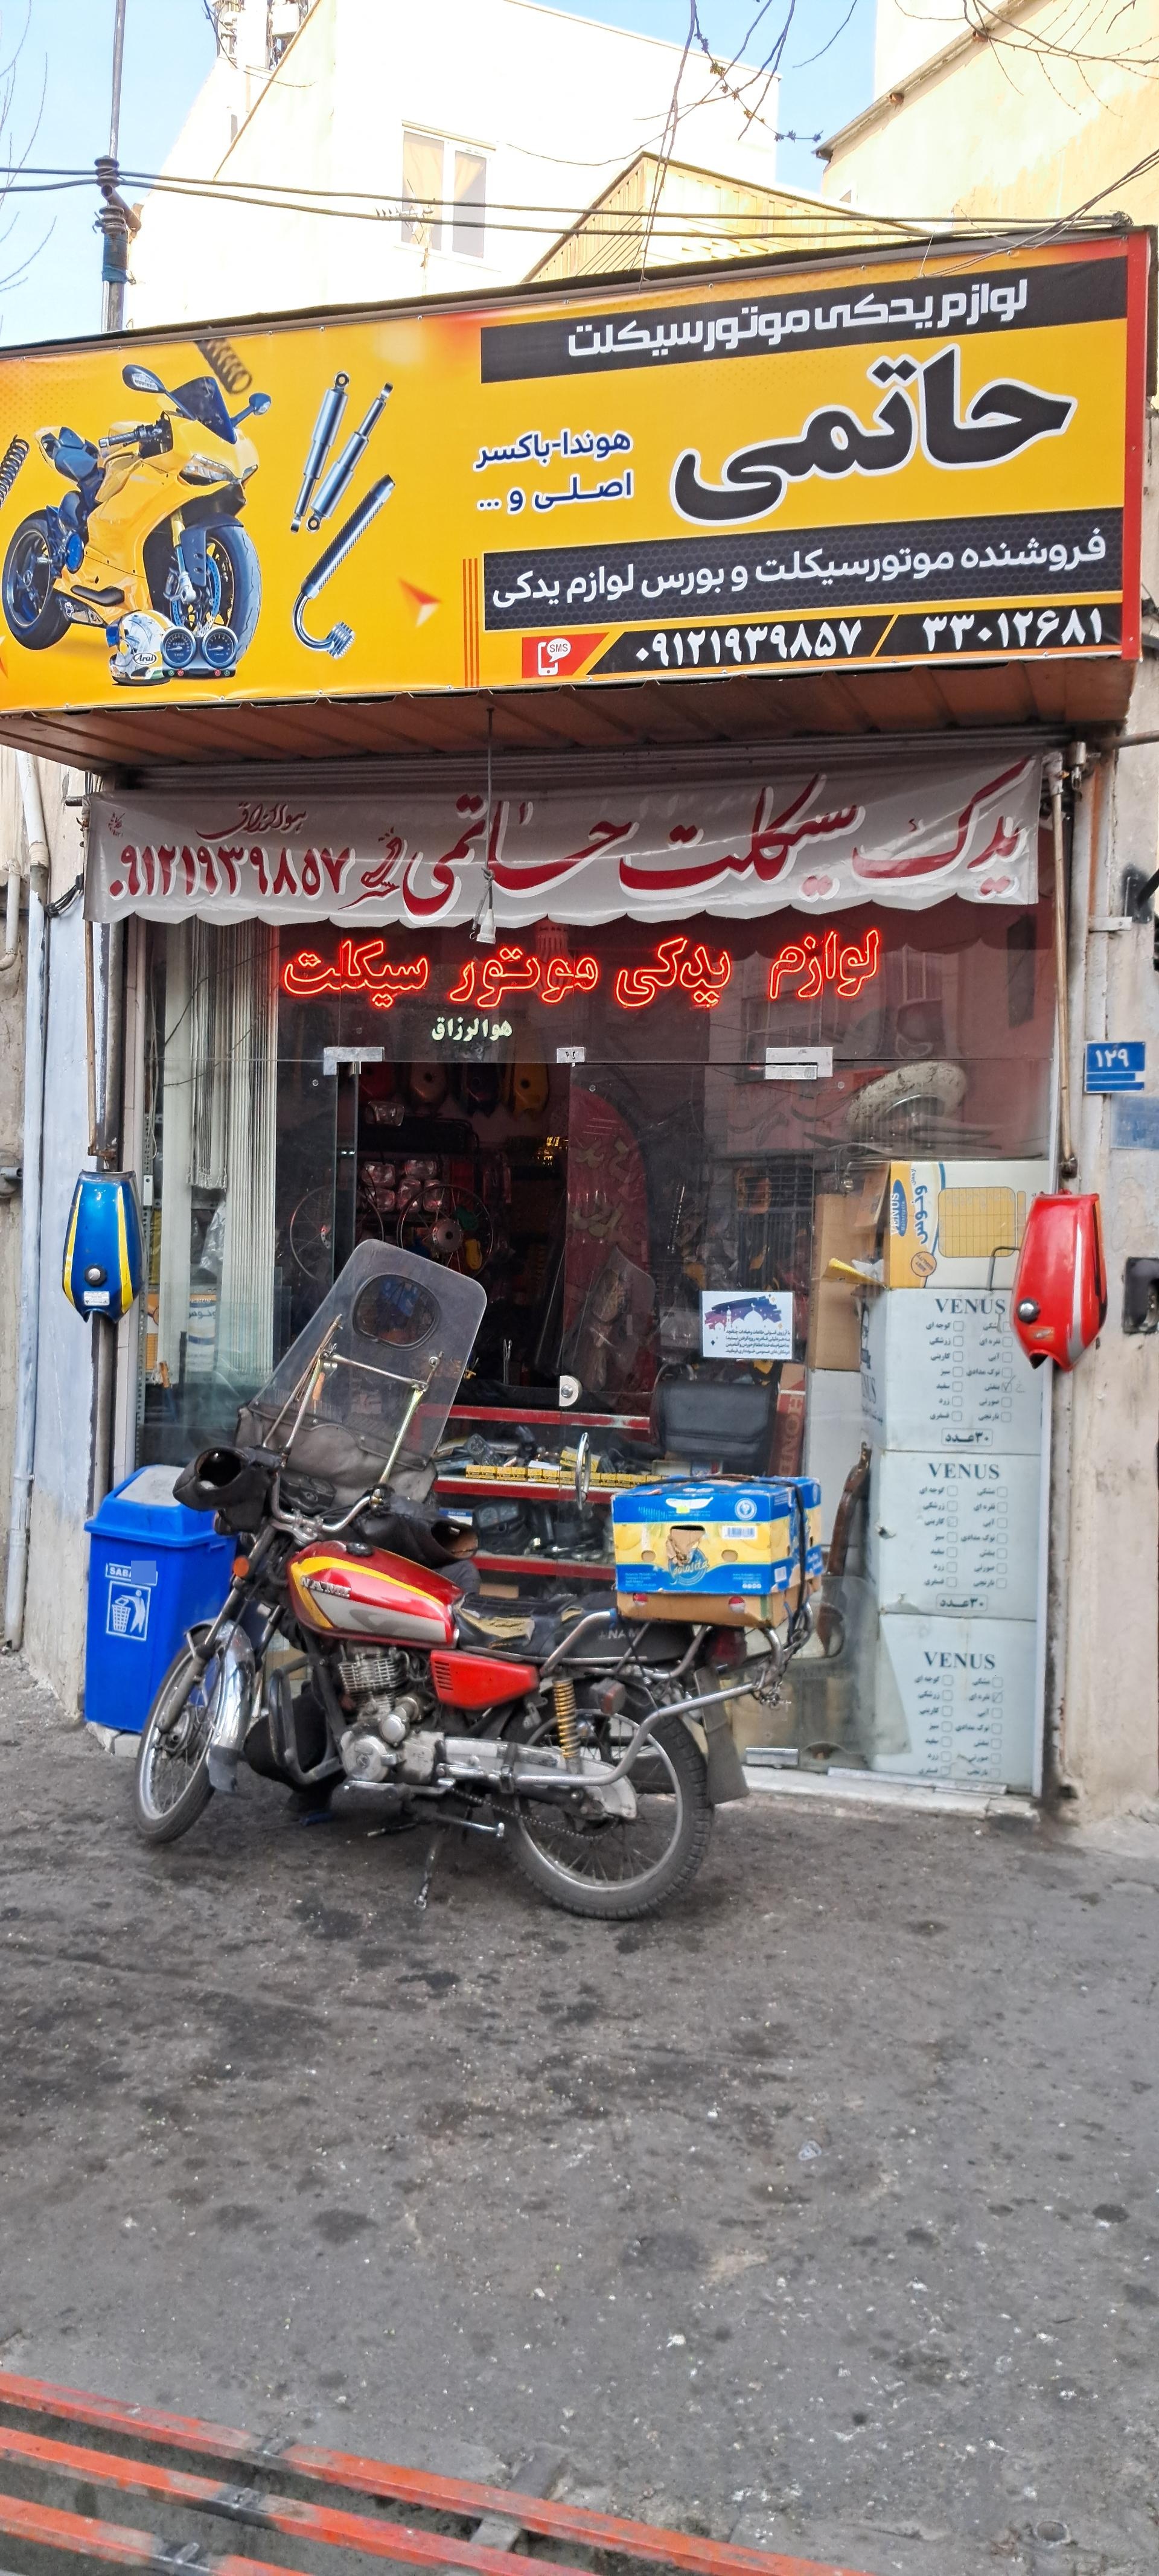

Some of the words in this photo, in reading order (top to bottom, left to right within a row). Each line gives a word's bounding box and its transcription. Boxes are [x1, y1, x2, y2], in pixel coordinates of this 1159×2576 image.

[815, 293, 937, 331] یدکی
[942, 280, 1028, 330] لوازم
[670, 344, 1077, 525] حاتمی
[508, 490, 525, 513] و
[533, 471, 633, 510] اصلی
[755, 545, 954, 587] موتورسیکلت
[960, 528, 1107, 571] فروشنده
[493, 571, 562, 609] یدکی
[566, 564, 634, 604] لوازم
[640, 566, 726, 599] بورس
[731, 567, 749, 593] و
[549, 644, 569, 654] SMS
[635, 619, 863, 668] ۰۹۱۲۱۹۳۹۸۵۷
[921, 607, 1104, 651] ۳۳۰۱۲۶۸۱
[137, 654, 153, 662] Arai
[619, 773, 866, 902] سیکلت
[109, 845, 357, 901] ۰۹۱۲۱۹۳۹۸۵۷
[403, 794, 639, 924] حاتمی
[282, 939, 429, 1009] سیکلت
[447, 946, 599, 1008] موتور
[616, 936, 732, 1008] یدکی
[768, 928, 881, 1000] لوازم
[1096, 1049, 1129, 1067] ۱۲۹
[890, 1192, 900, 1236] VENUS
[912, 1185, 928, 1245] ونوس
[935, 1298, 1006, 1315] VENUS
[983, 1322, 1000, 1331] شکی
[928, 1463, 1000, 1479] VENUS
[924, 1651, 996, 1670] VENUS
